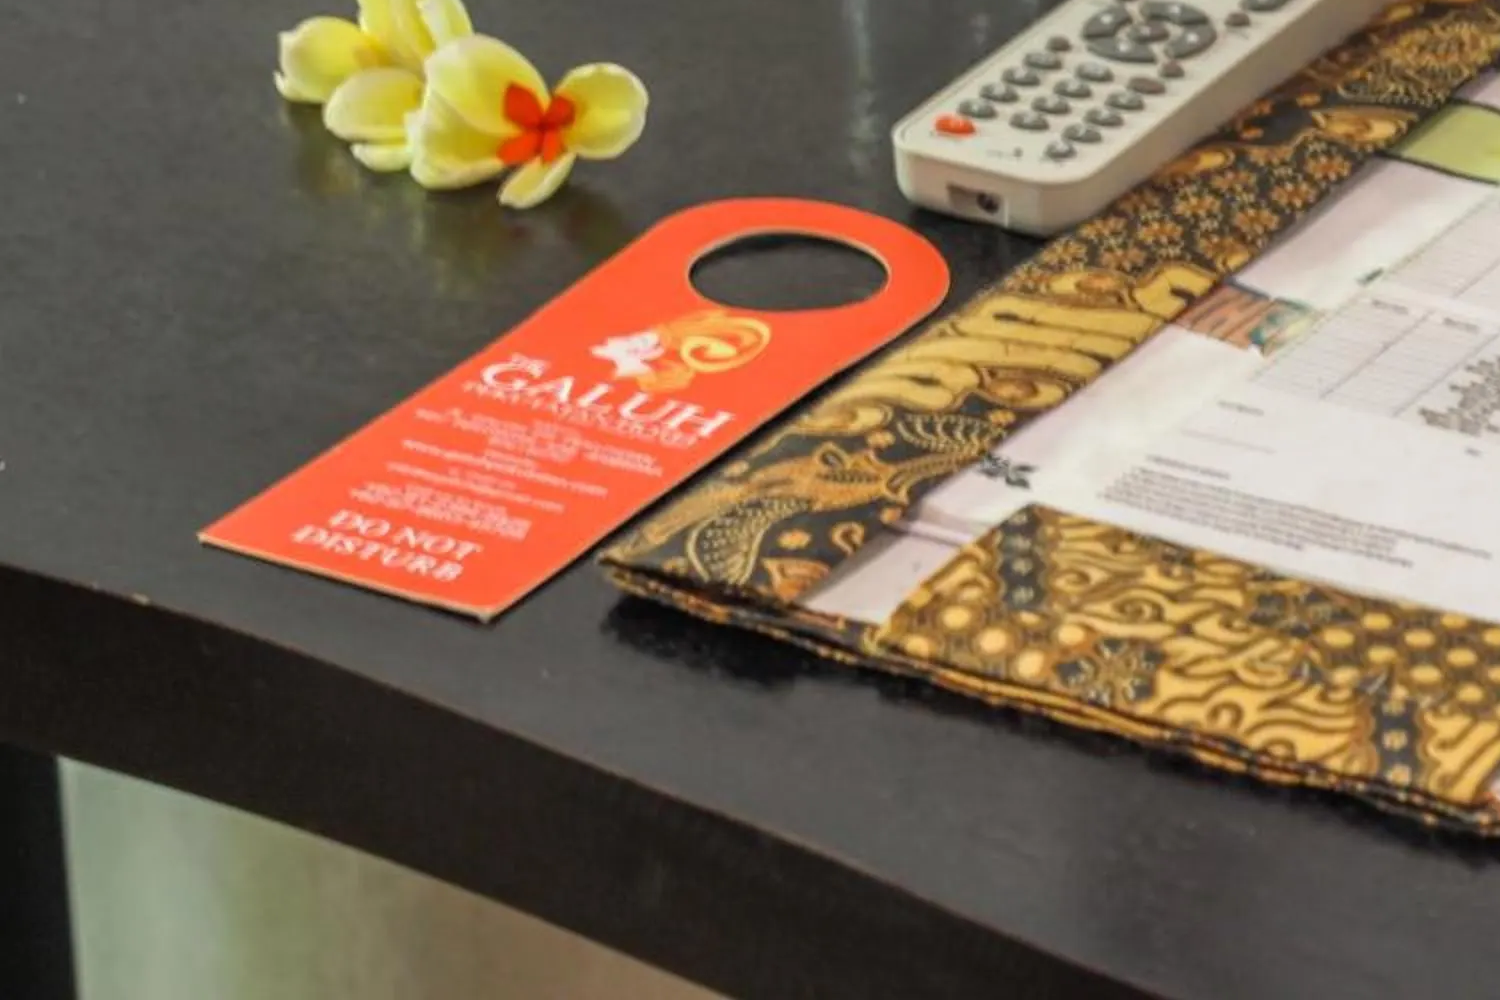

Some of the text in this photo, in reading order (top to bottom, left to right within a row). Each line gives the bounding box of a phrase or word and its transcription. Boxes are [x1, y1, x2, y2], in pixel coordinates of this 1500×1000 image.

[481, 361, 734, 437] GALUH
[291, 524, 463, 581] DISTURB
[329, 509, 390, 537] DO
[393, 526, 483, 560] NOT
